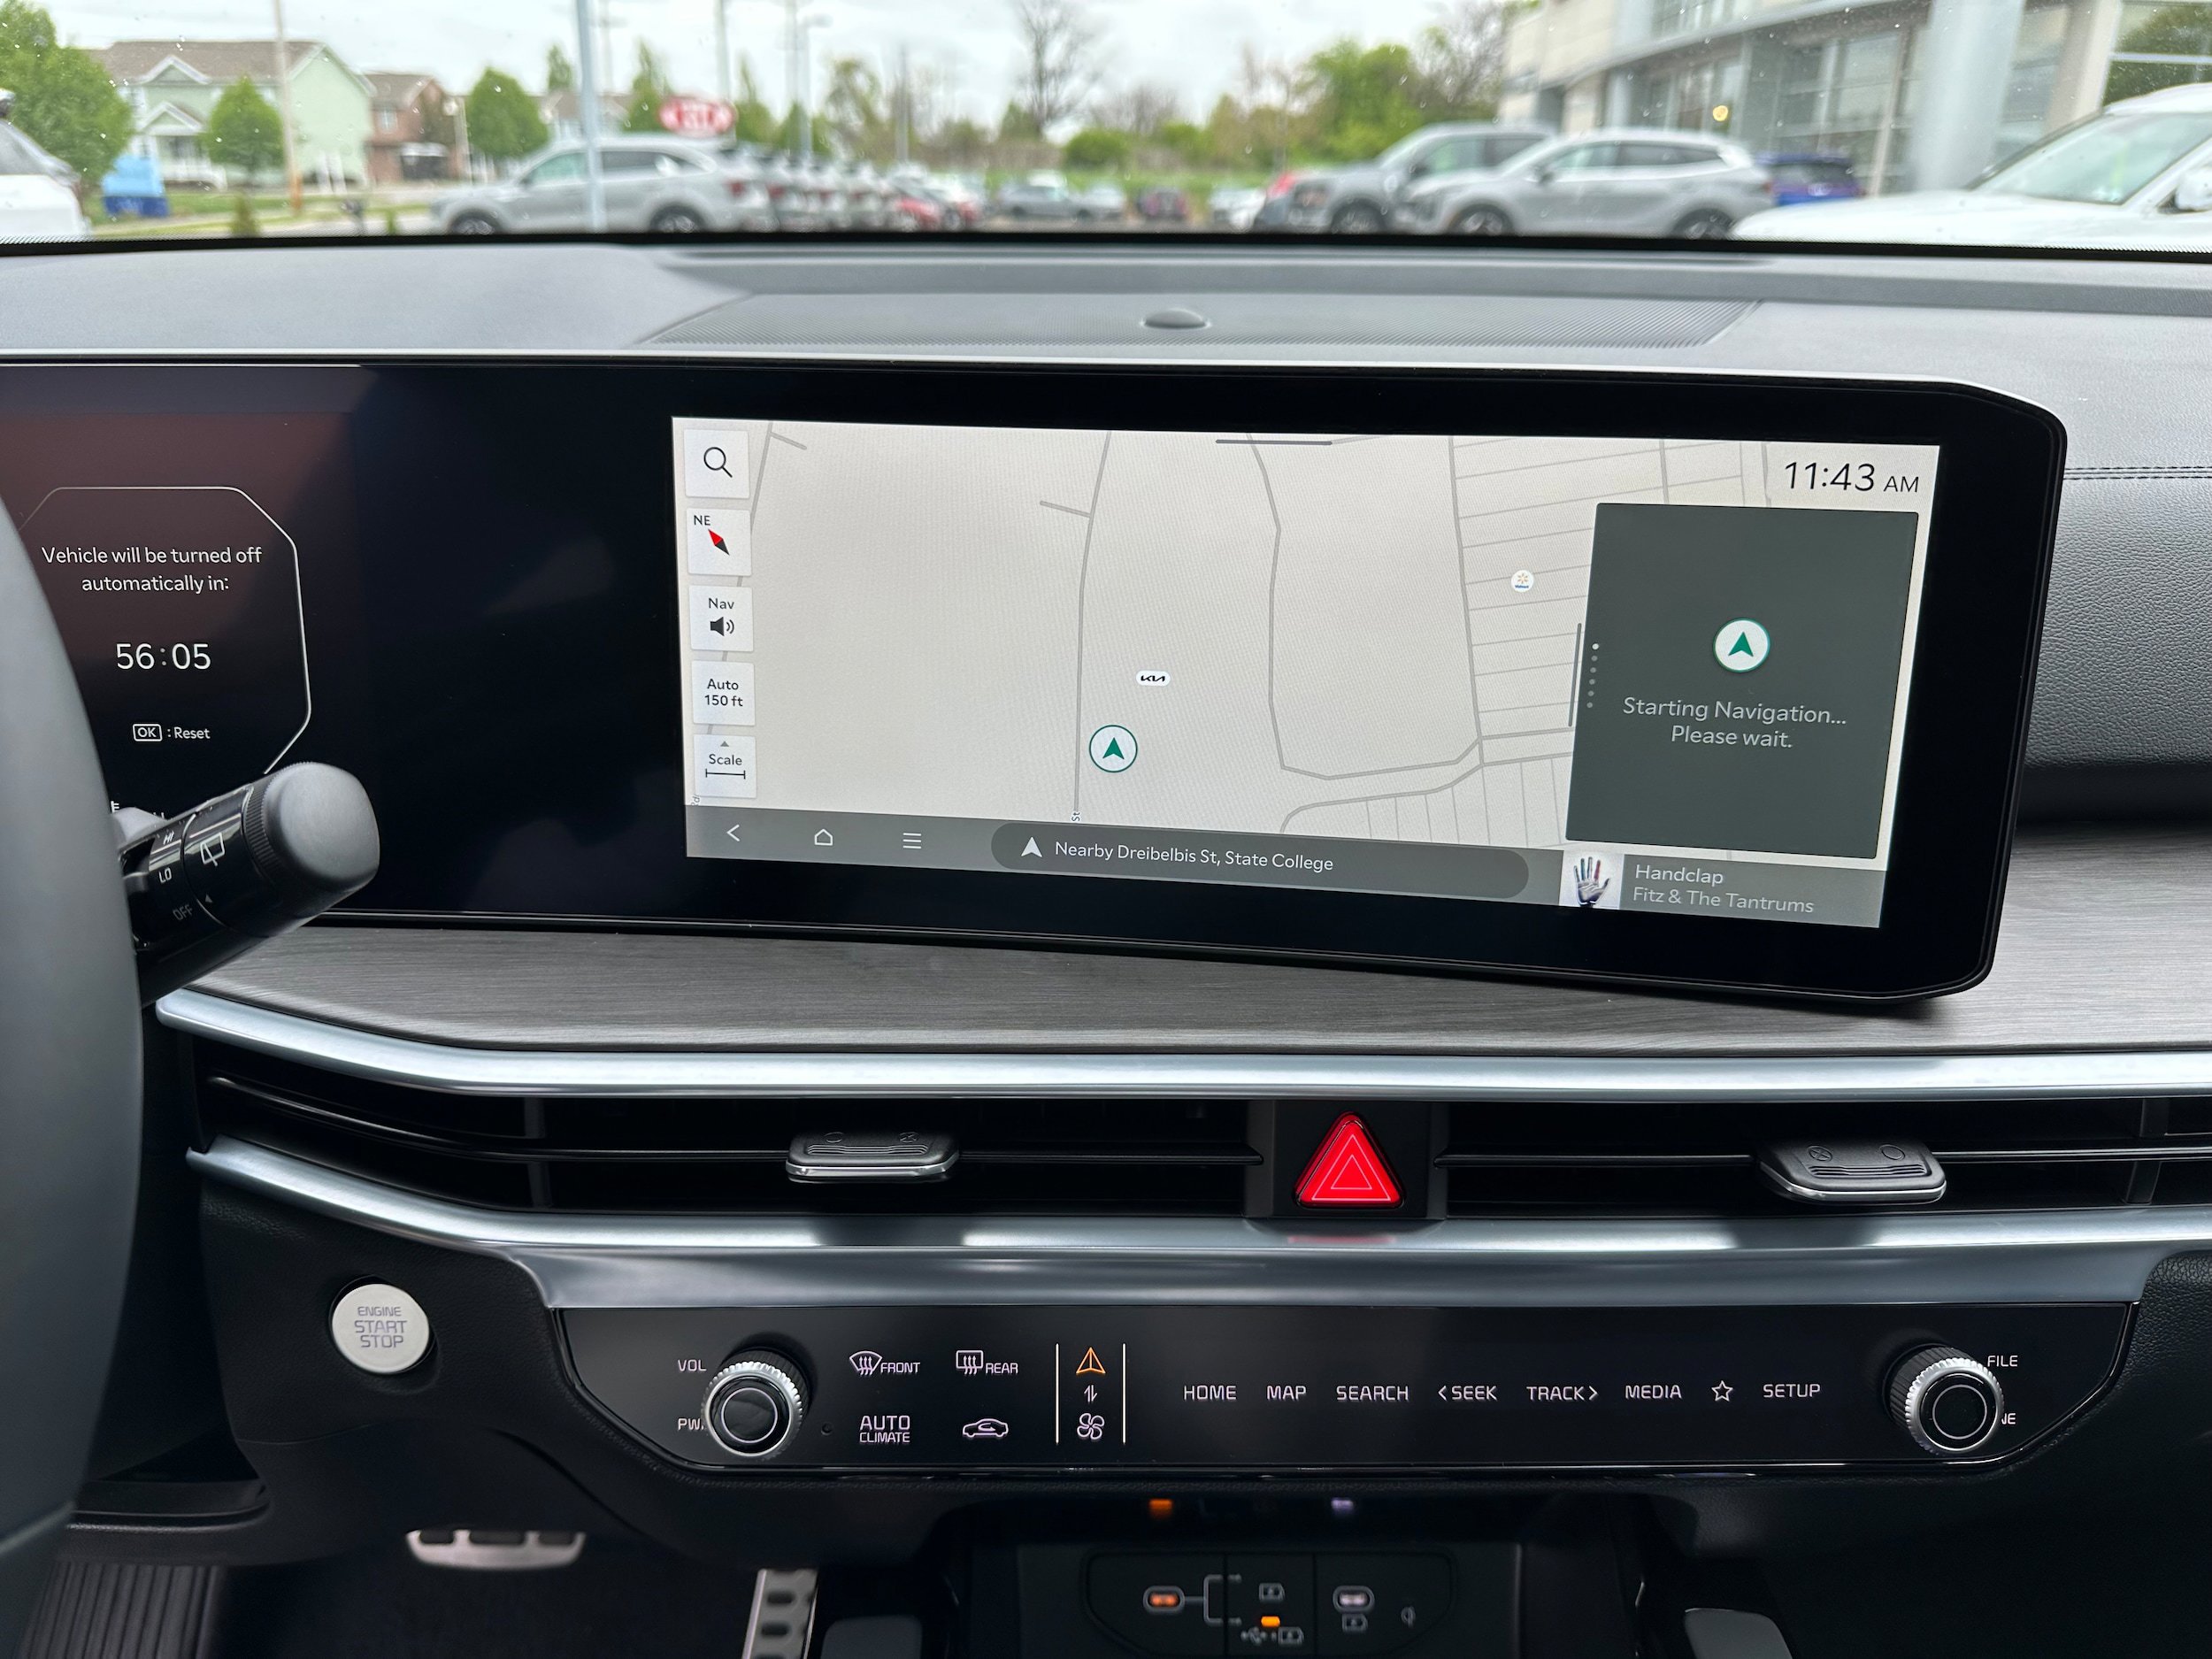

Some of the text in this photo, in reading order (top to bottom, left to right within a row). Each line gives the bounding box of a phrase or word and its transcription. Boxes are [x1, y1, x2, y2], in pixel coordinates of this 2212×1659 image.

[1785, 461, 1919, 493] 11:43 AM
[694, 515, 711, 526] NE
[42, 546, 262, 564] Vehicle will be turned off
[81, 575, 229, 595] automatically in:
[708, 597, 734, 610] Nav
[116, 643, 211, 670] 56:05
[707, 679, 739, 691] Auto
[704, 695, 743, 707] 150 ft
[1623, 696, 1847, 725] Starting Navigation...
[137, 726, 157, 739] OK
[1671, 725, 1793, 748] Please wait.
[709, 754, 742, 766] Scale
[1071, 811, 1080, 822] St
[1055, 841, 1333, 873] Nearby Dreibelbis St, State College
[159, 867, 173, 884] LO
[1635, 864, 1724, 887] Handclap
[1632, 886, 1815, 913] Fitz & The Tantrums
[173, 903, 194, 921] OFF
[357, 1306, 402, 1317] ENGINE
[354, 1320, 407, 1333] START
[360, 1334, 403, 1348] STOP
[678, 1359, 707, 1371] VOL
[880, 1362, 920, 1373] FRONT
[1987, 1355, 2018, 1367] FILE
[985, 1363, 1018, 1374] REAR
[1184, 1385, 1237, 1401] HOME
[1266, 1385, 1307, 1401] MAP
[1336, 1386, 1409, 1401] SEARCH
[1624, 1385, 1682, 1400] MEDIA
[1763, 1384, 1820, 1398] SETUP
[678, 1417, 704, 1430] PW
[859, 1415, 910, 1431] AUTO
[859, 1432, 910, 1443] CLIMATE
